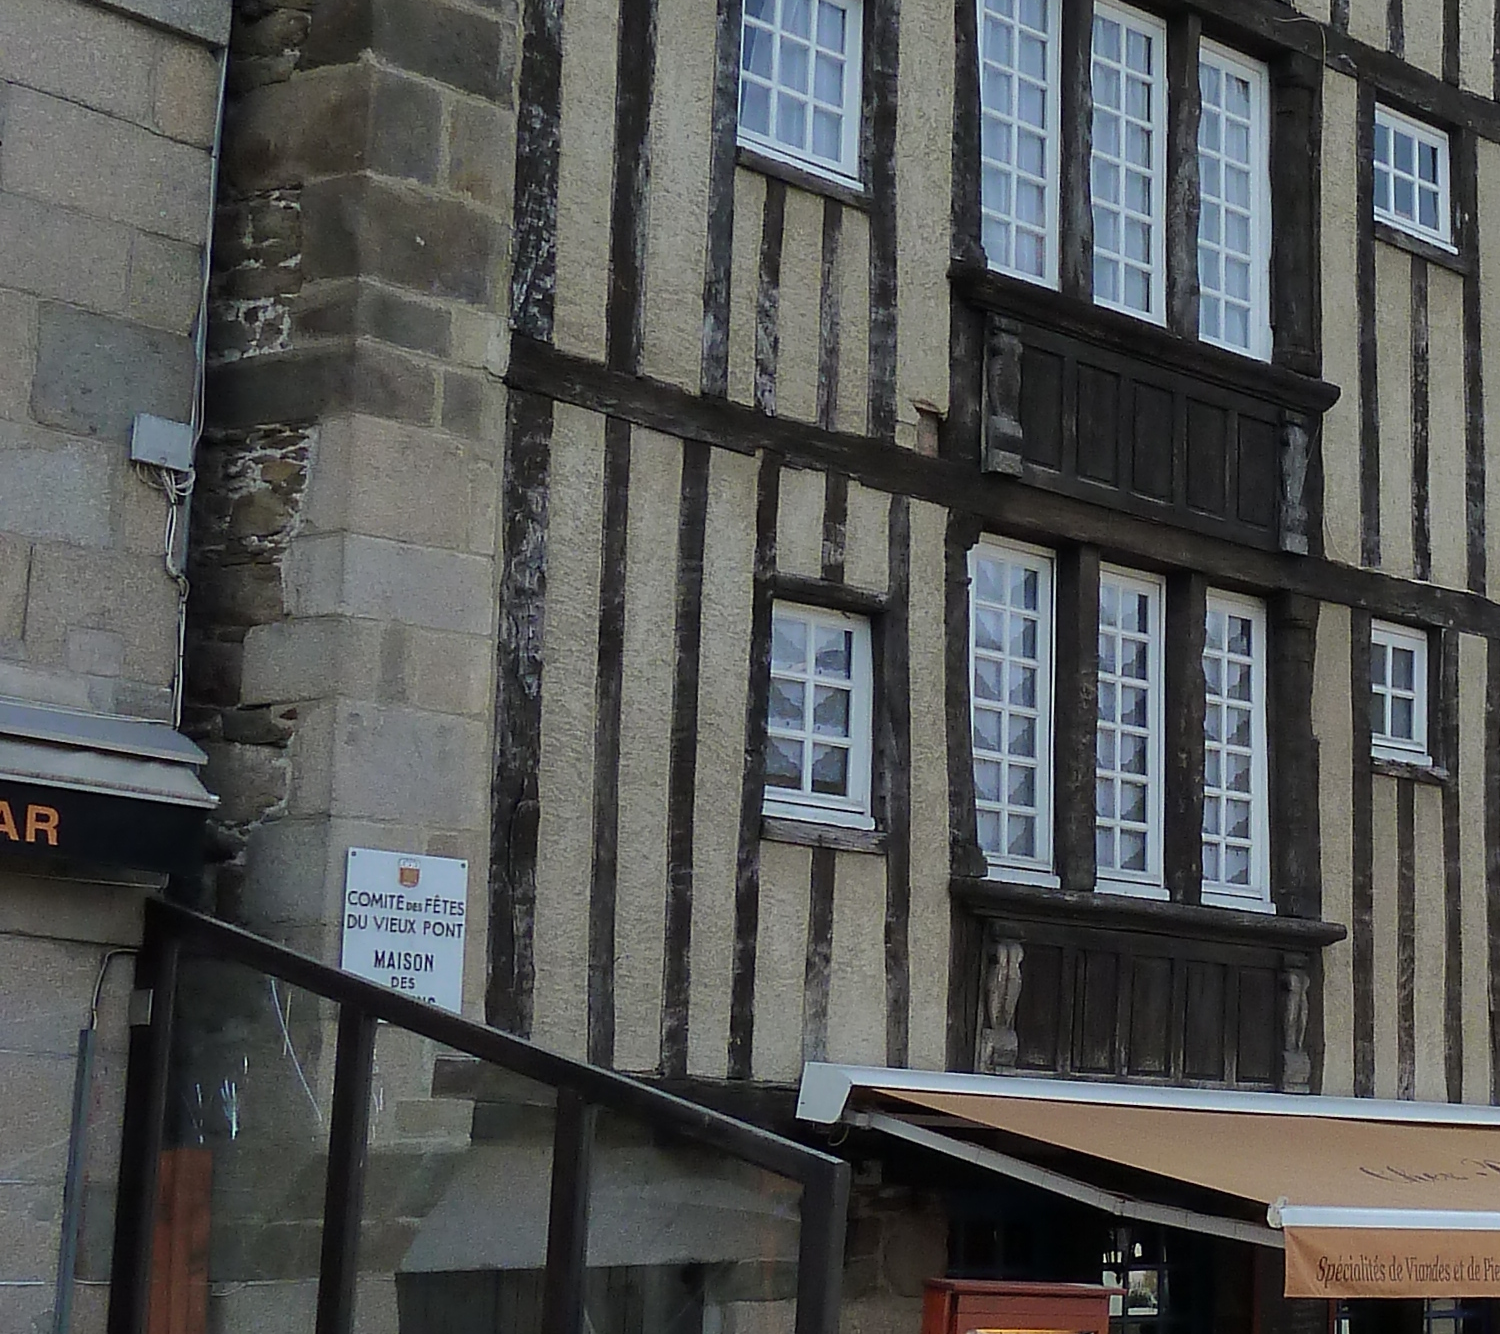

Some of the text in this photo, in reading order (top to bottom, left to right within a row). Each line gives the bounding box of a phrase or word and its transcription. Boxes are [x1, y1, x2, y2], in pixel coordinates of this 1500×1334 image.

[347, 890, 465, 916] COMITÉ DES FÊTES
[346, 914, 464, 938] DU VIEUX PONT
[374, 949, 434, 972] MAISON
[391, 976, 416, 989] DES
[1316, 1254, 1386, 1288] Spécialités
[1388, 1255, 1403, 1283] de
[1405, 1255, 1450, 1283] Viandes
[1453, 1258, 1464, 1282] et
[1467, 1255, 1481, 1283] de
